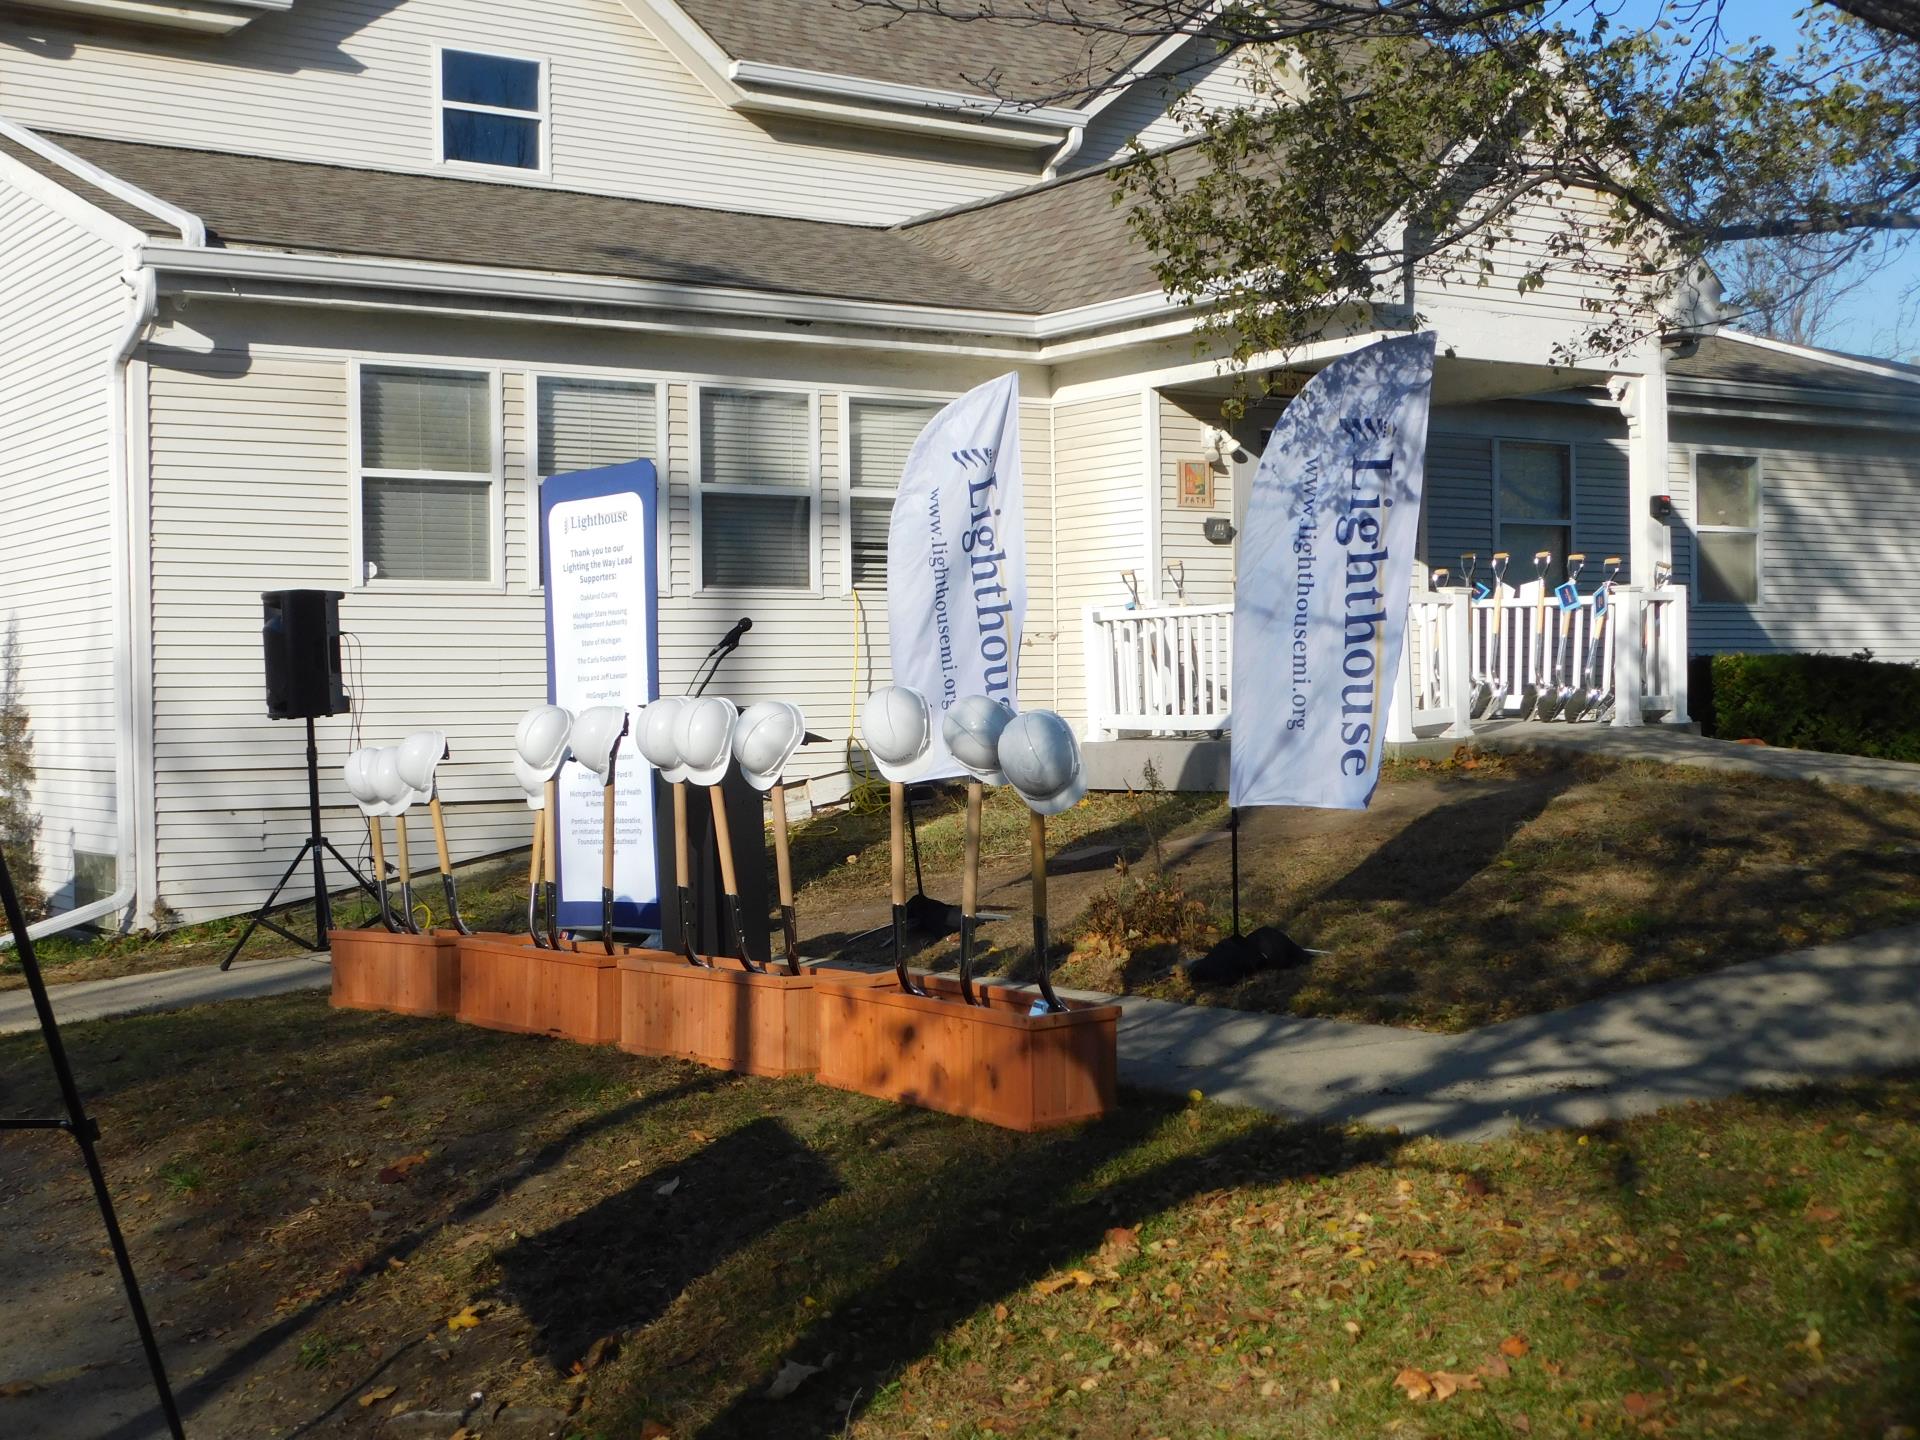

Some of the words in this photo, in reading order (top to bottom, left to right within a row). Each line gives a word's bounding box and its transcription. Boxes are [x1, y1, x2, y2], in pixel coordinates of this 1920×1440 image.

[562, 562, 590, 574] Lighting
[590, 560, 601, 569] the
[602, 559, 616, 568] Way
[617, 555, 632, 566] Lead
[570, 510, 628, 531] Lighthouse
[570, 548, 590, 558] Thank
[592, 547, 604, 557] you
[604, 546, 612, 554] to
[579, 573, 617, 584] Supporters:
[929, 487, 957, 710] www.lighthousemi.org
[962, 472, 1013, 708] Lighthou
[1287, 455, 1319, 731] www.lighthousemi.org
[1336, 452, 1393, 776] Lighthouse
